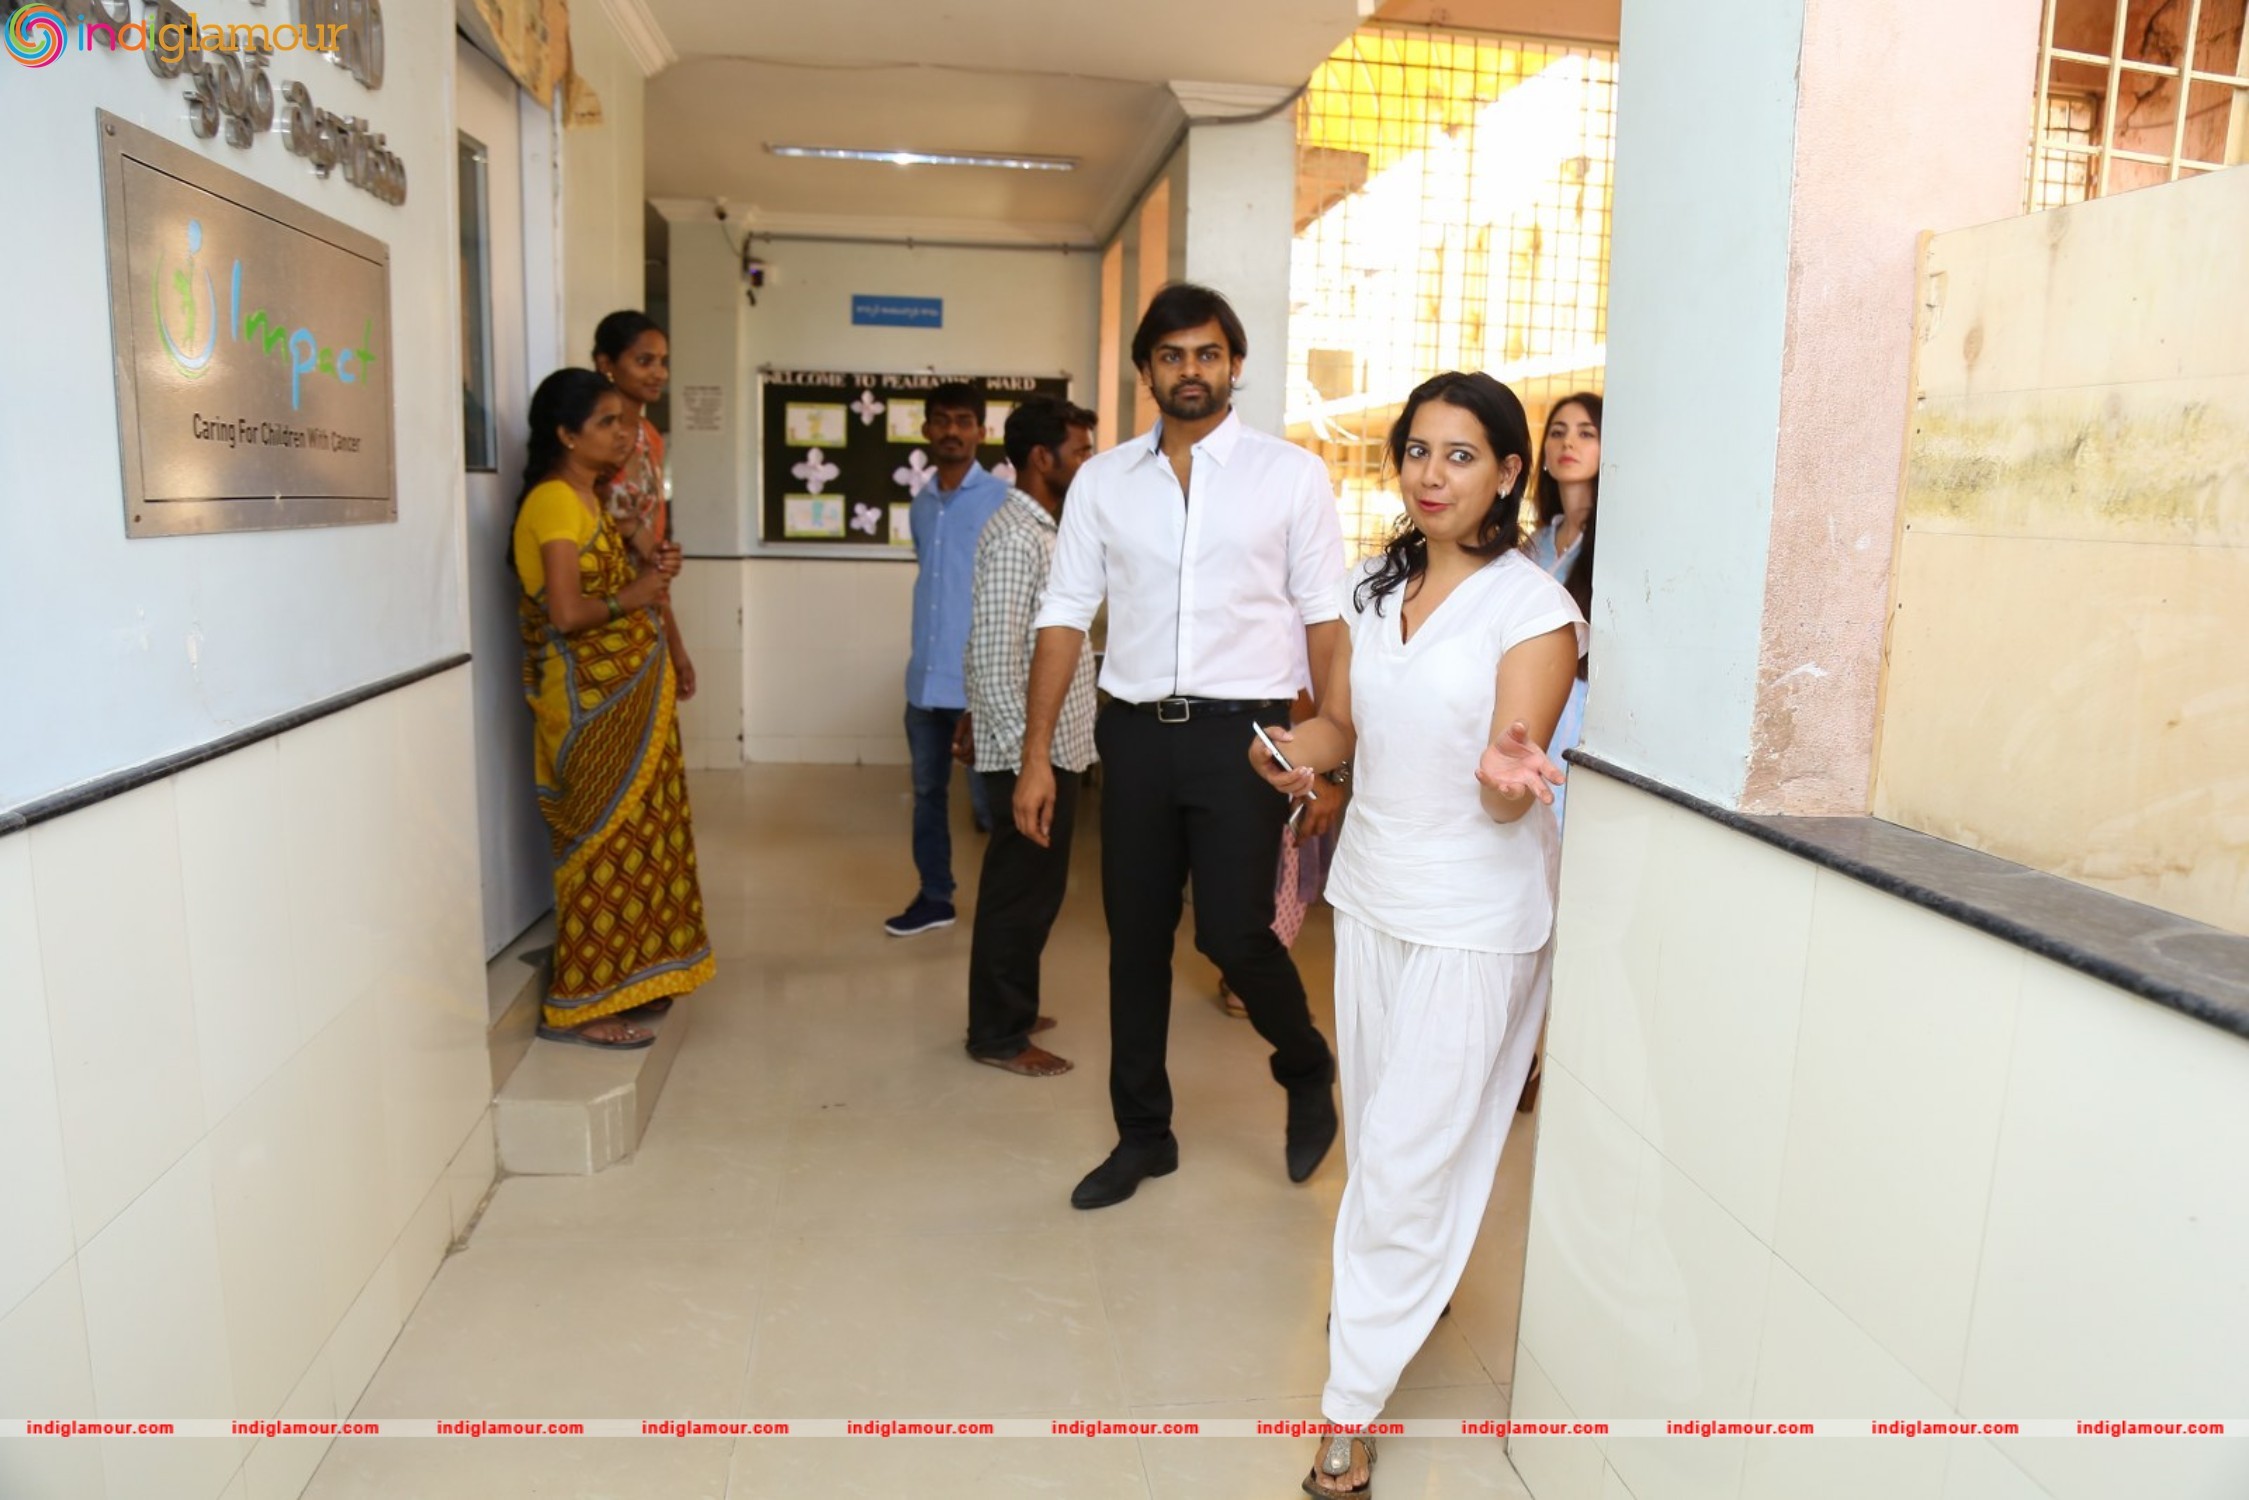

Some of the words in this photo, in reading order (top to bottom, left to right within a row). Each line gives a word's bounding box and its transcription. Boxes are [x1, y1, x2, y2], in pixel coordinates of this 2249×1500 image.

[231, 258, 375, 411] Impact
[854, 373, 877, 389] TO
[986, 377, 1037, 390] WARD
[193, 412, 236, 449] Caring
[238, 418, 258, 444] For
[261, 422, 306, 448] Children
[307, 427, 329, 450] With
[331, 431, 361, 452] Cancer
